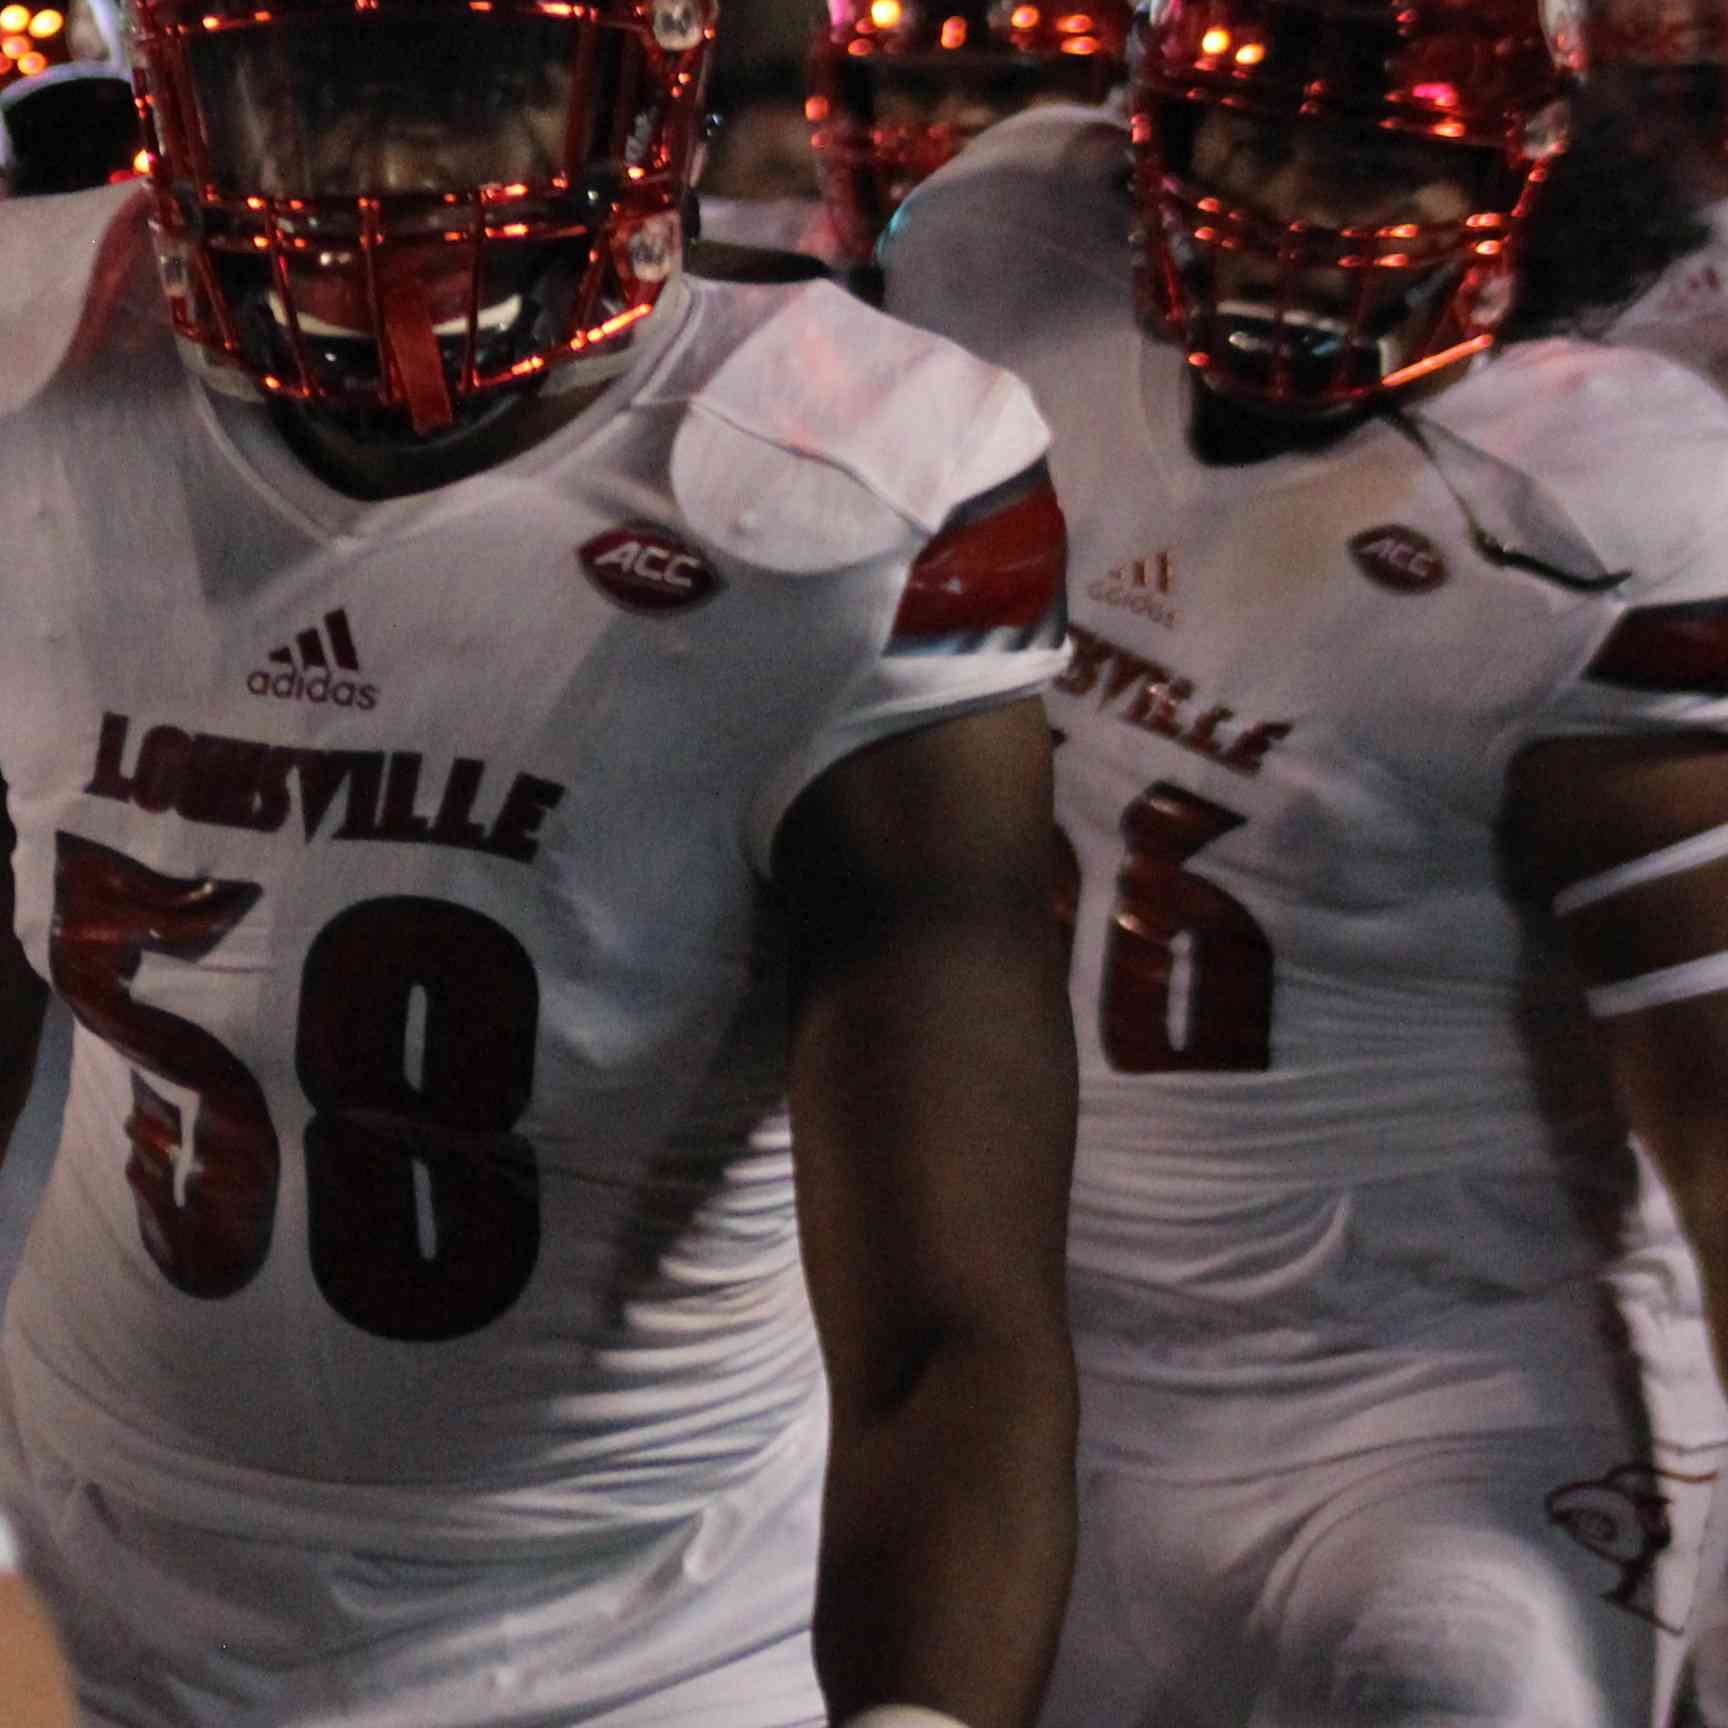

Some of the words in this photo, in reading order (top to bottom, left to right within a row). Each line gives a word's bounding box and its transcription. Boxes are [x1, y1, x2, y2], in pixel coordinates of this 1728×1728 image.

[593, 538, 702, 589] ACC
[1358, 535, 1429, 578] ACC
[246, 667, 381, 712] adidas
[84, 712, 567, 864] LOUISVILLE
[48, 828, 542, 1344] 58
